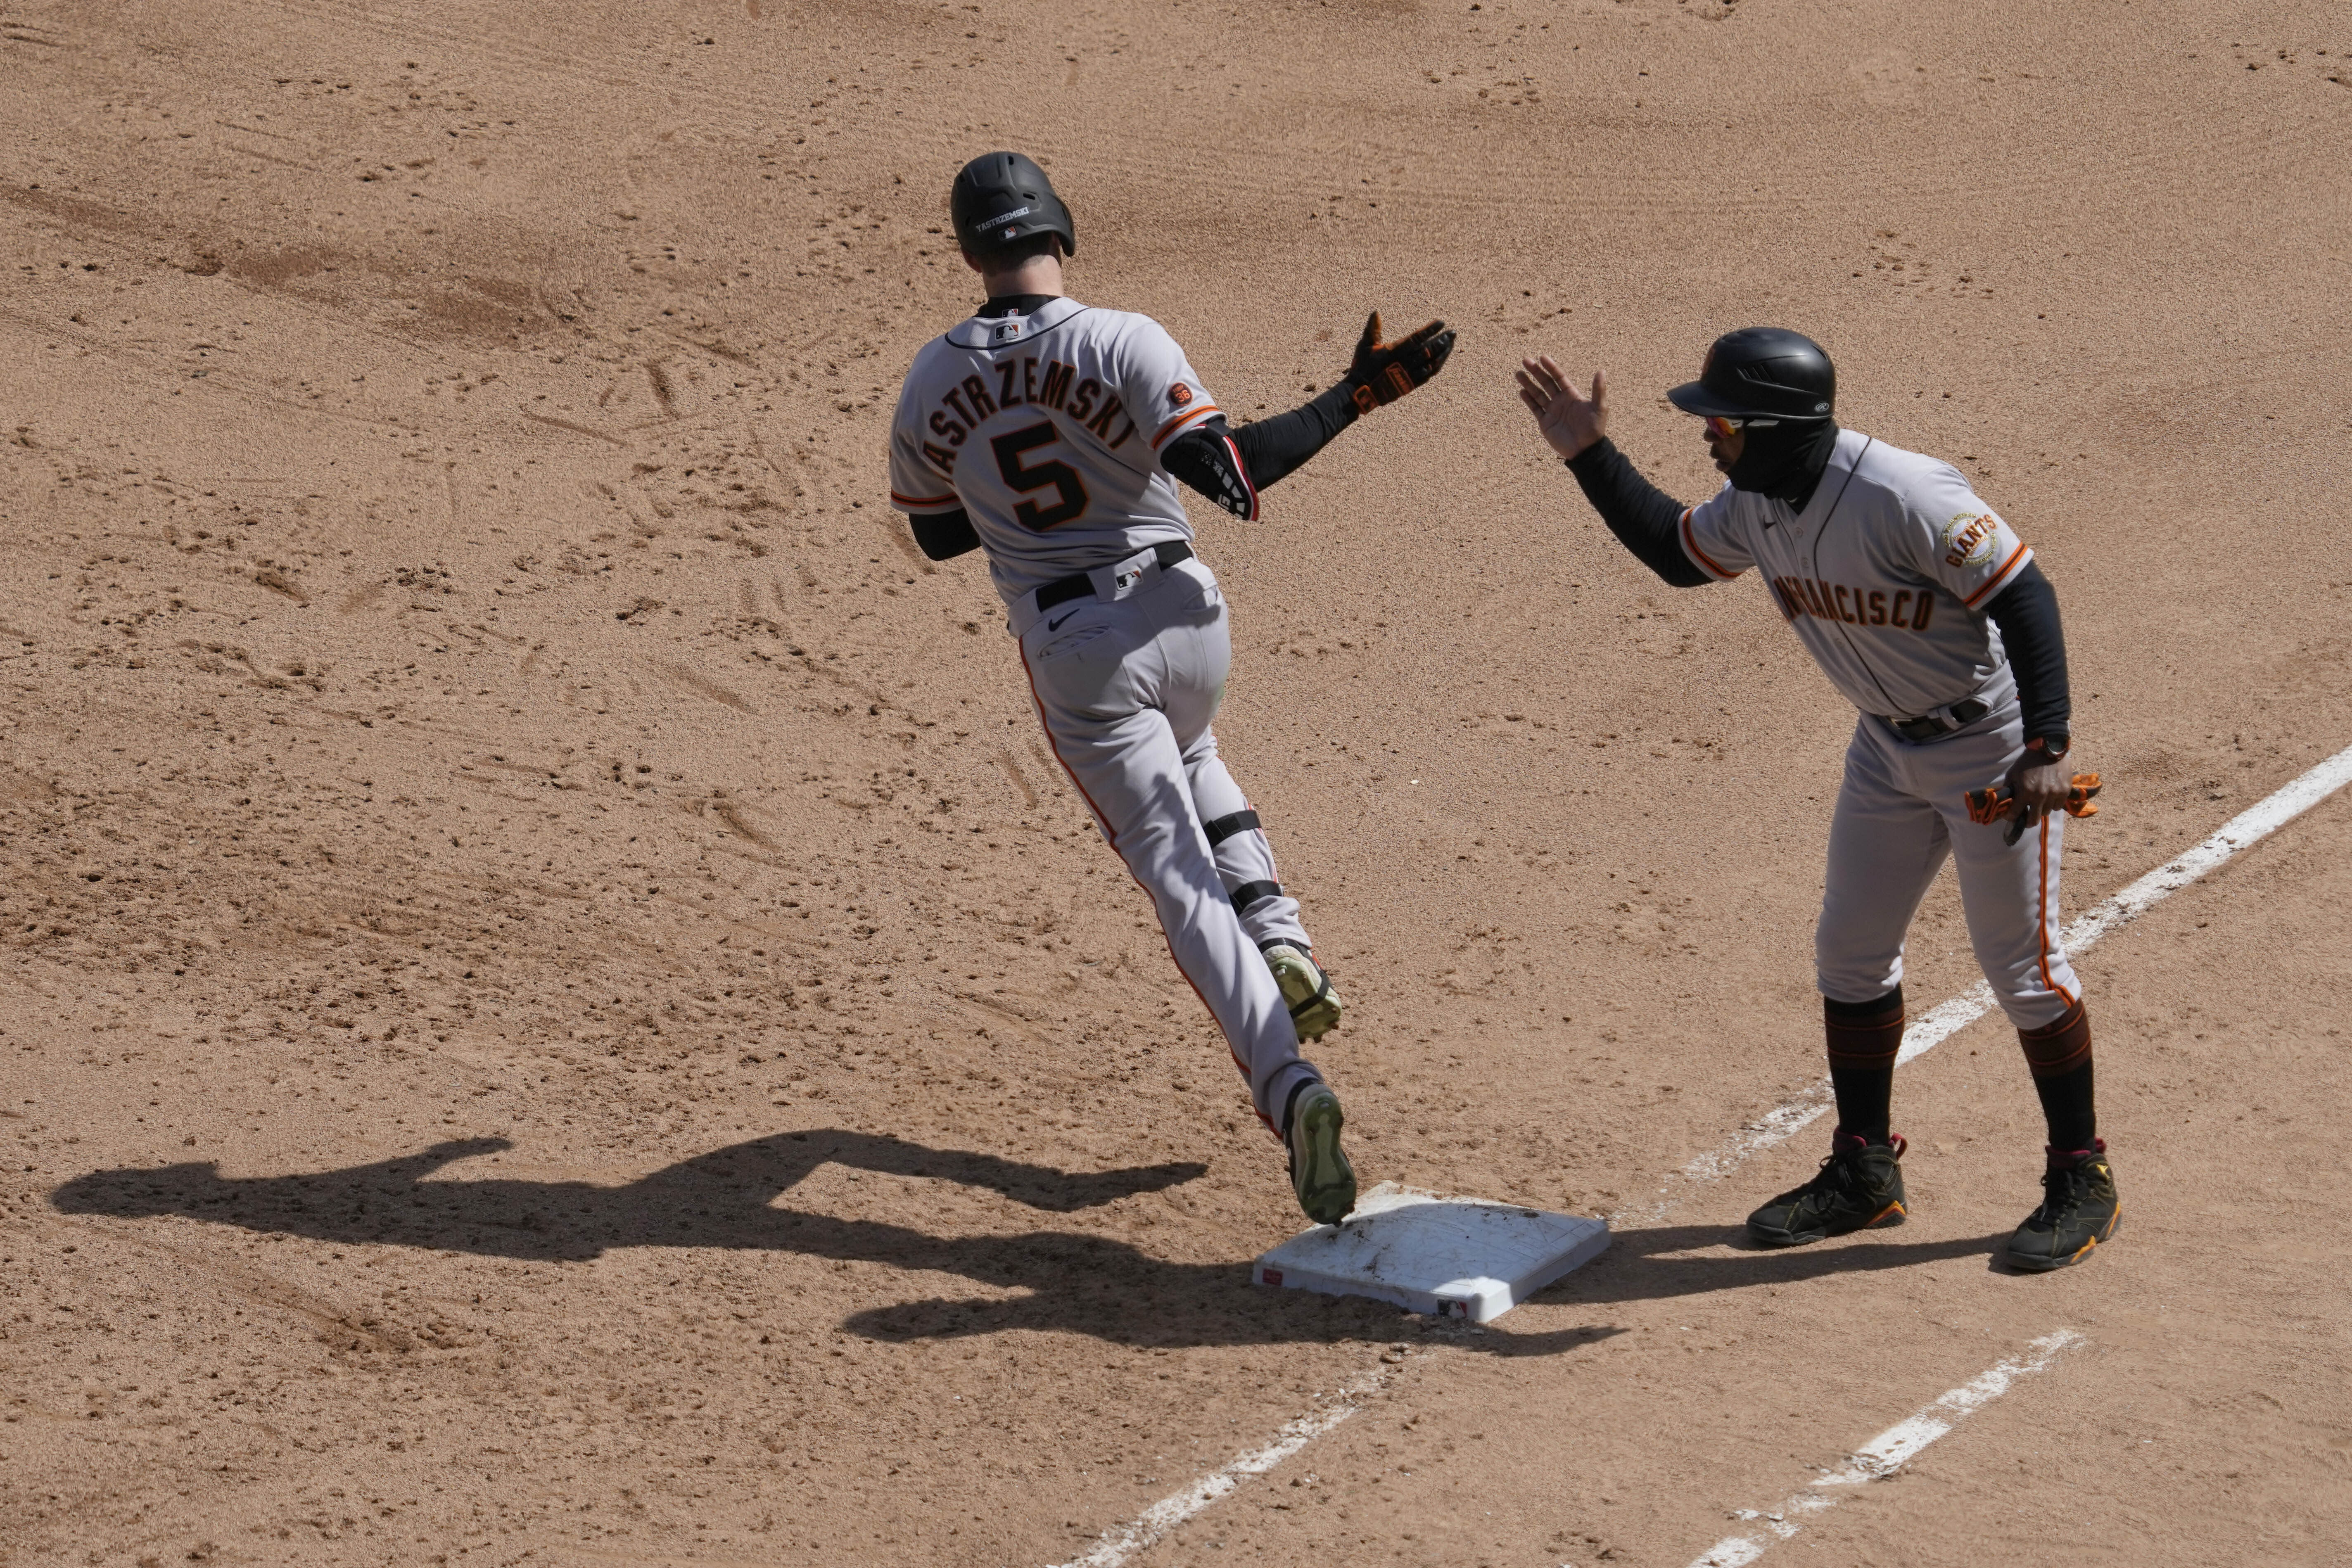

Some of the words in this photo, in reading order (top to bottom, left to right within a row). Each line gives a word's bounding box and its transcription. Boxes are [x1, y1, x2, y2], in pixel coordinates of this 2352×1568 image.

[975, 206, 1030, 232] YASTRZEMSKI
[923, 357, 1135, 487] ASTRZEMSKI
[1175, 389, 1191, 402] 36
[990, 419, 1090, 534] 5
[1945, 514, 1997, 568] GIANTS
